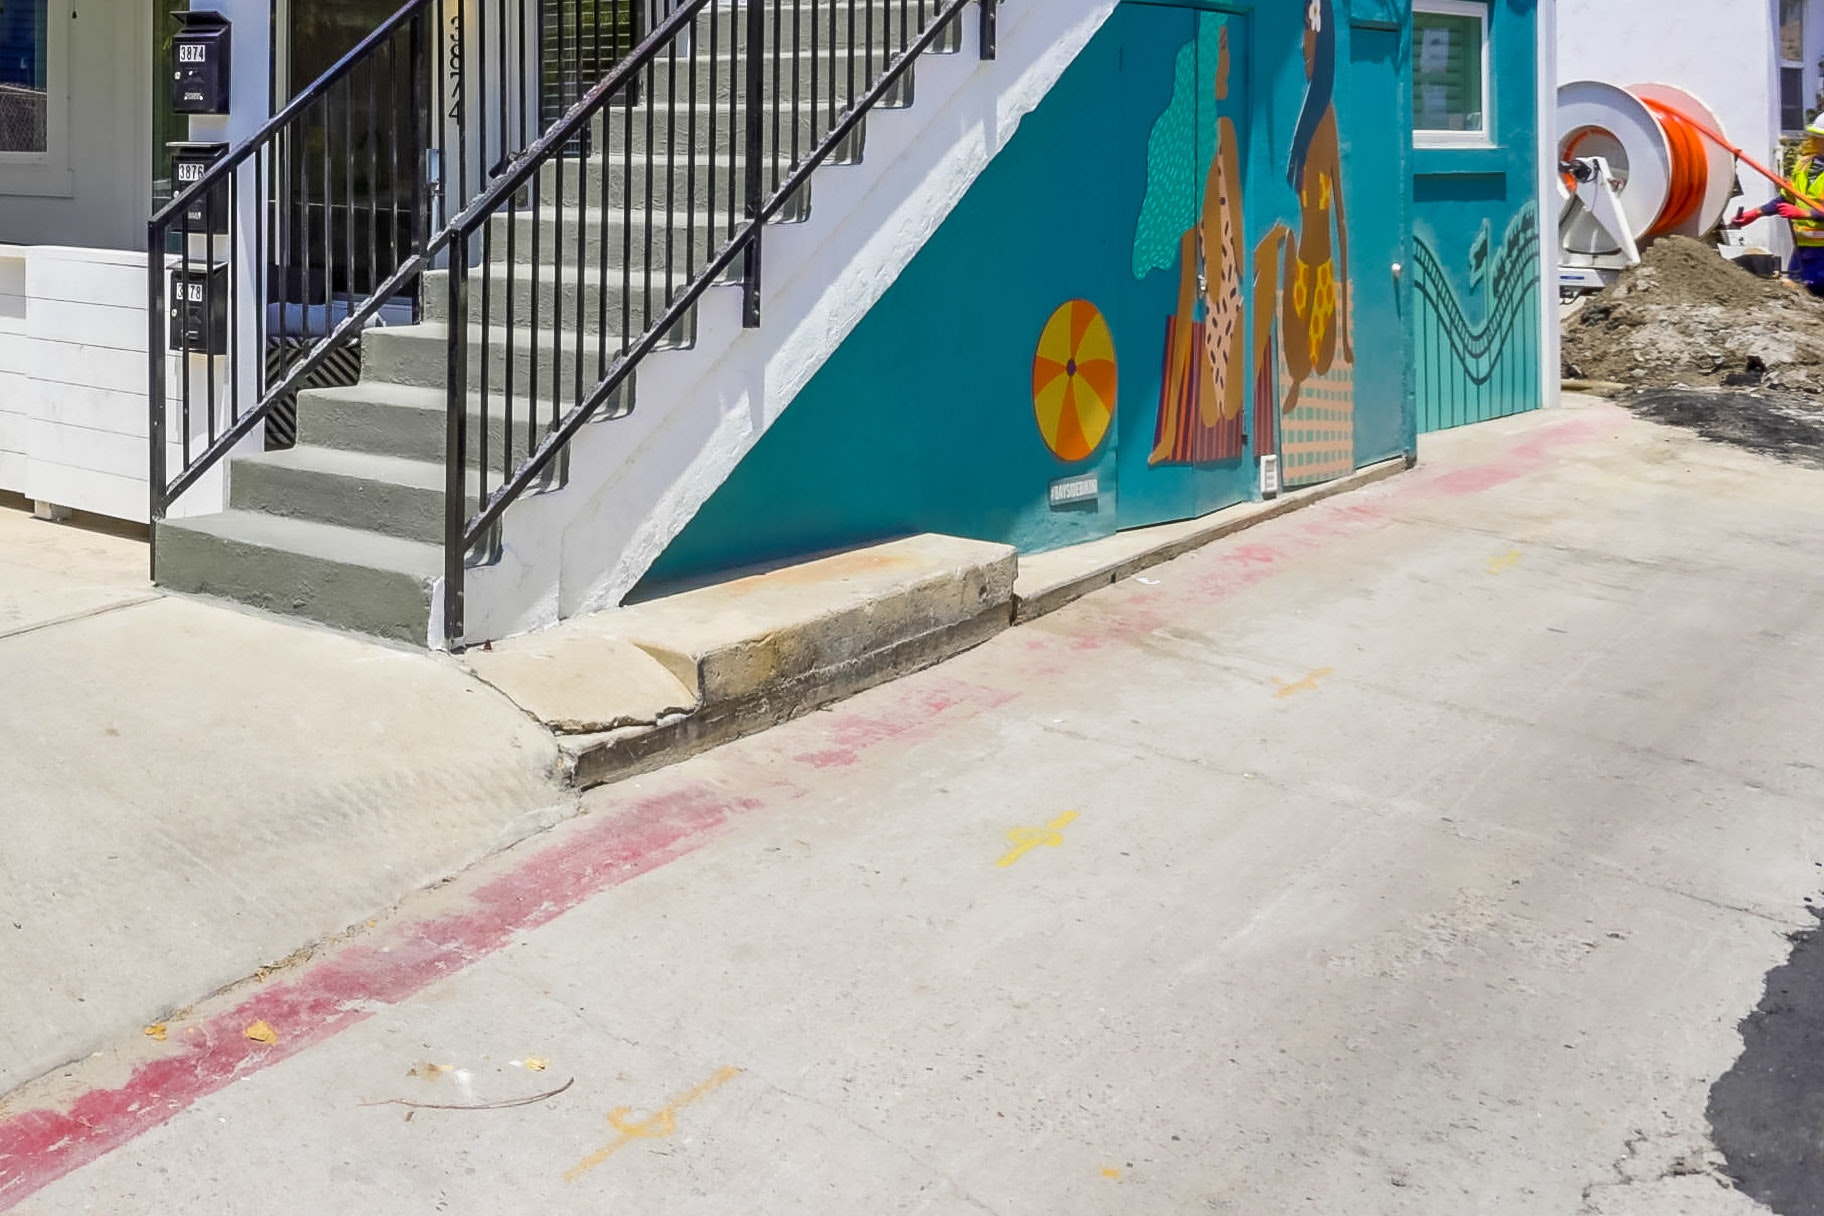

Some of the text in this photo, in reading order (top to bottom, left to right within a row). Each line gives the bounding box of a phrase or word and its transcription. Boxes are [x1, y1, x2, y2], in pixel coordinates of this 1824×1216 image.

[180, 46, 204, 61] 3874
[179, 165, 204, 180] 3876
[177, 284, 202, 300] 378
